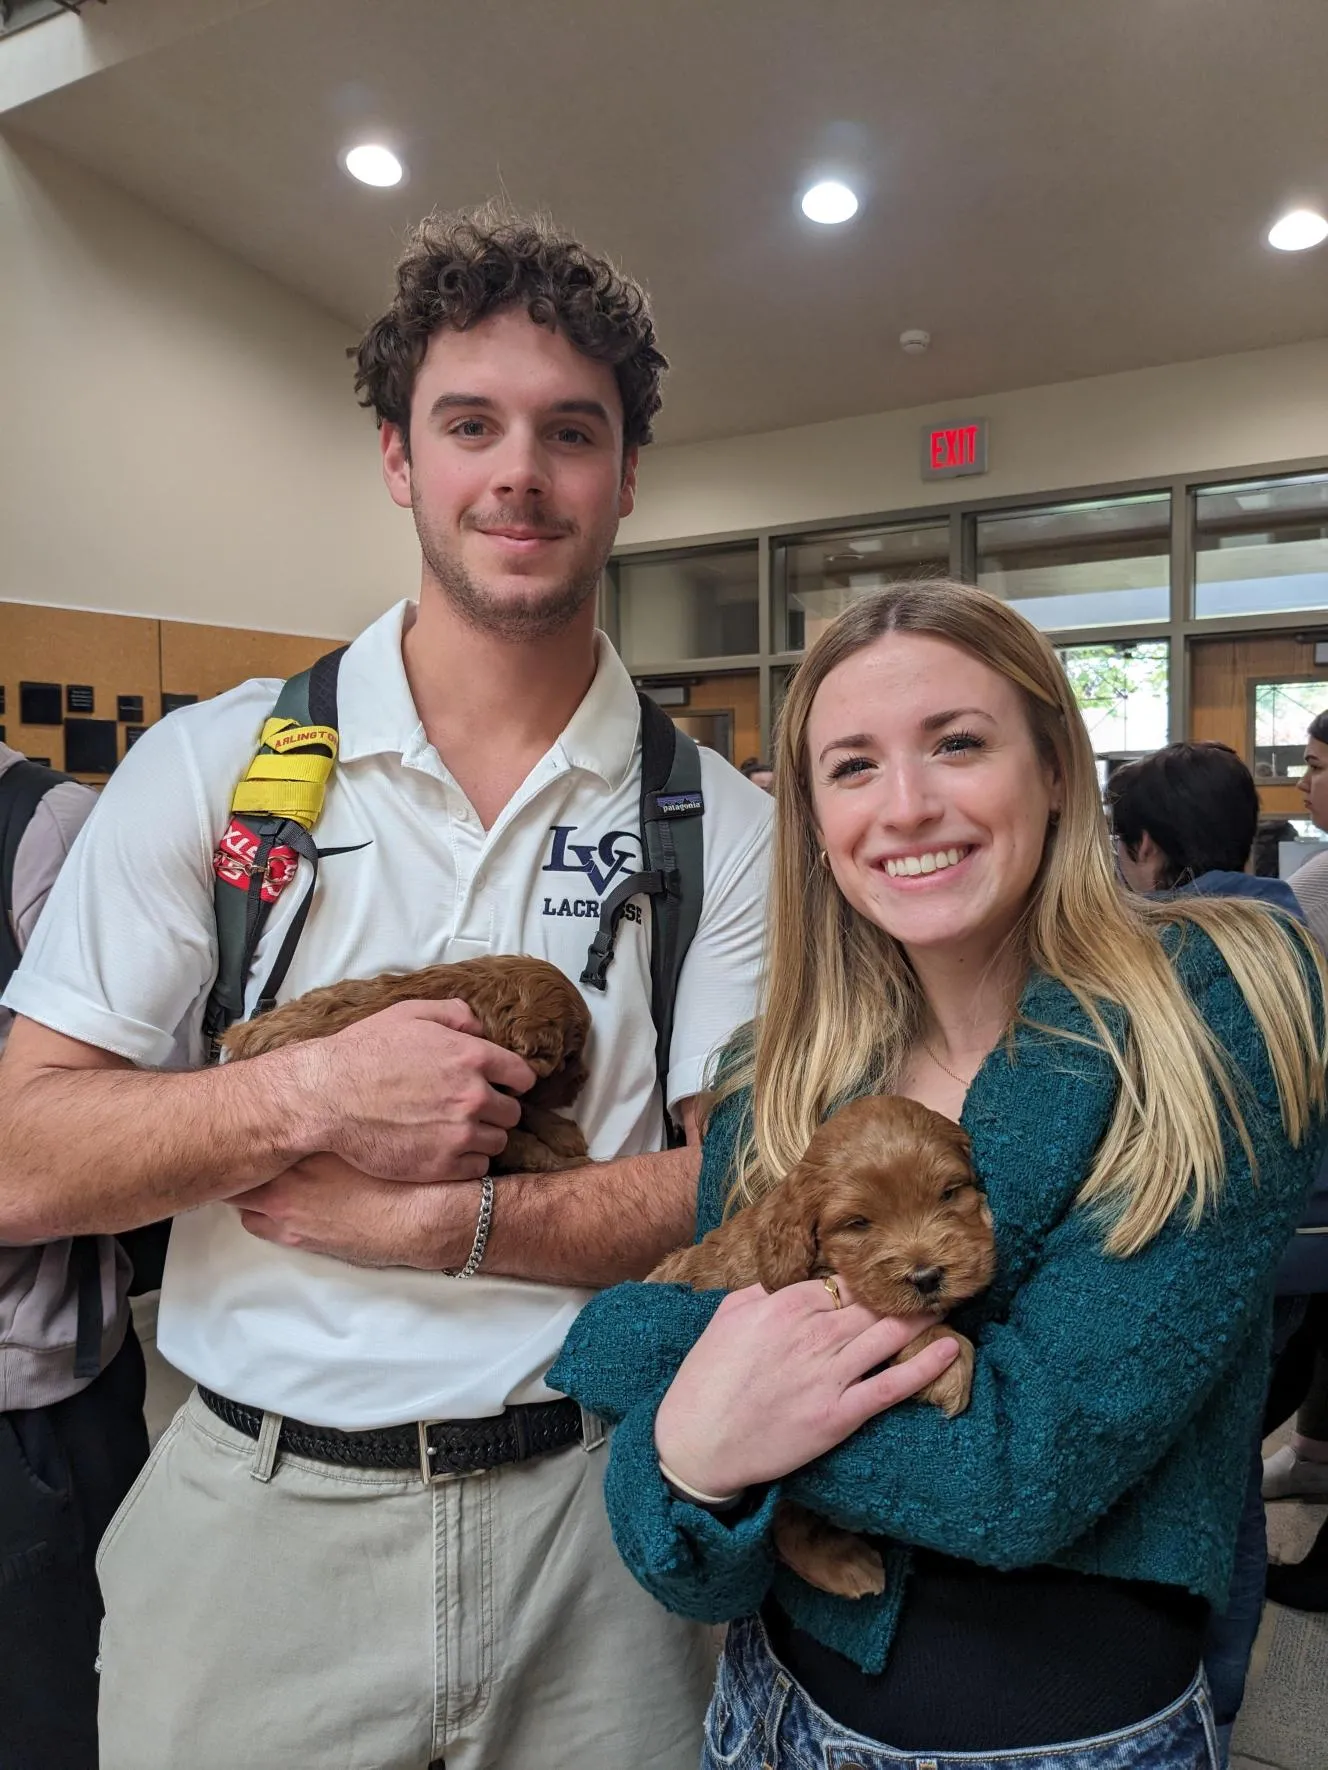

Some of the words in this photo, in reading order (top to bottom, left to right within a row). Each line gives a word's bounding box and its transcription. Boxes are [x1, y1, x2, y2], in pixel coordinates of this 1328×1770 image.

[931, 425, 978, 469] EXIT
[663, 802, 701, 813] patagonia
[542, 897, 642, 925] LACRSE
